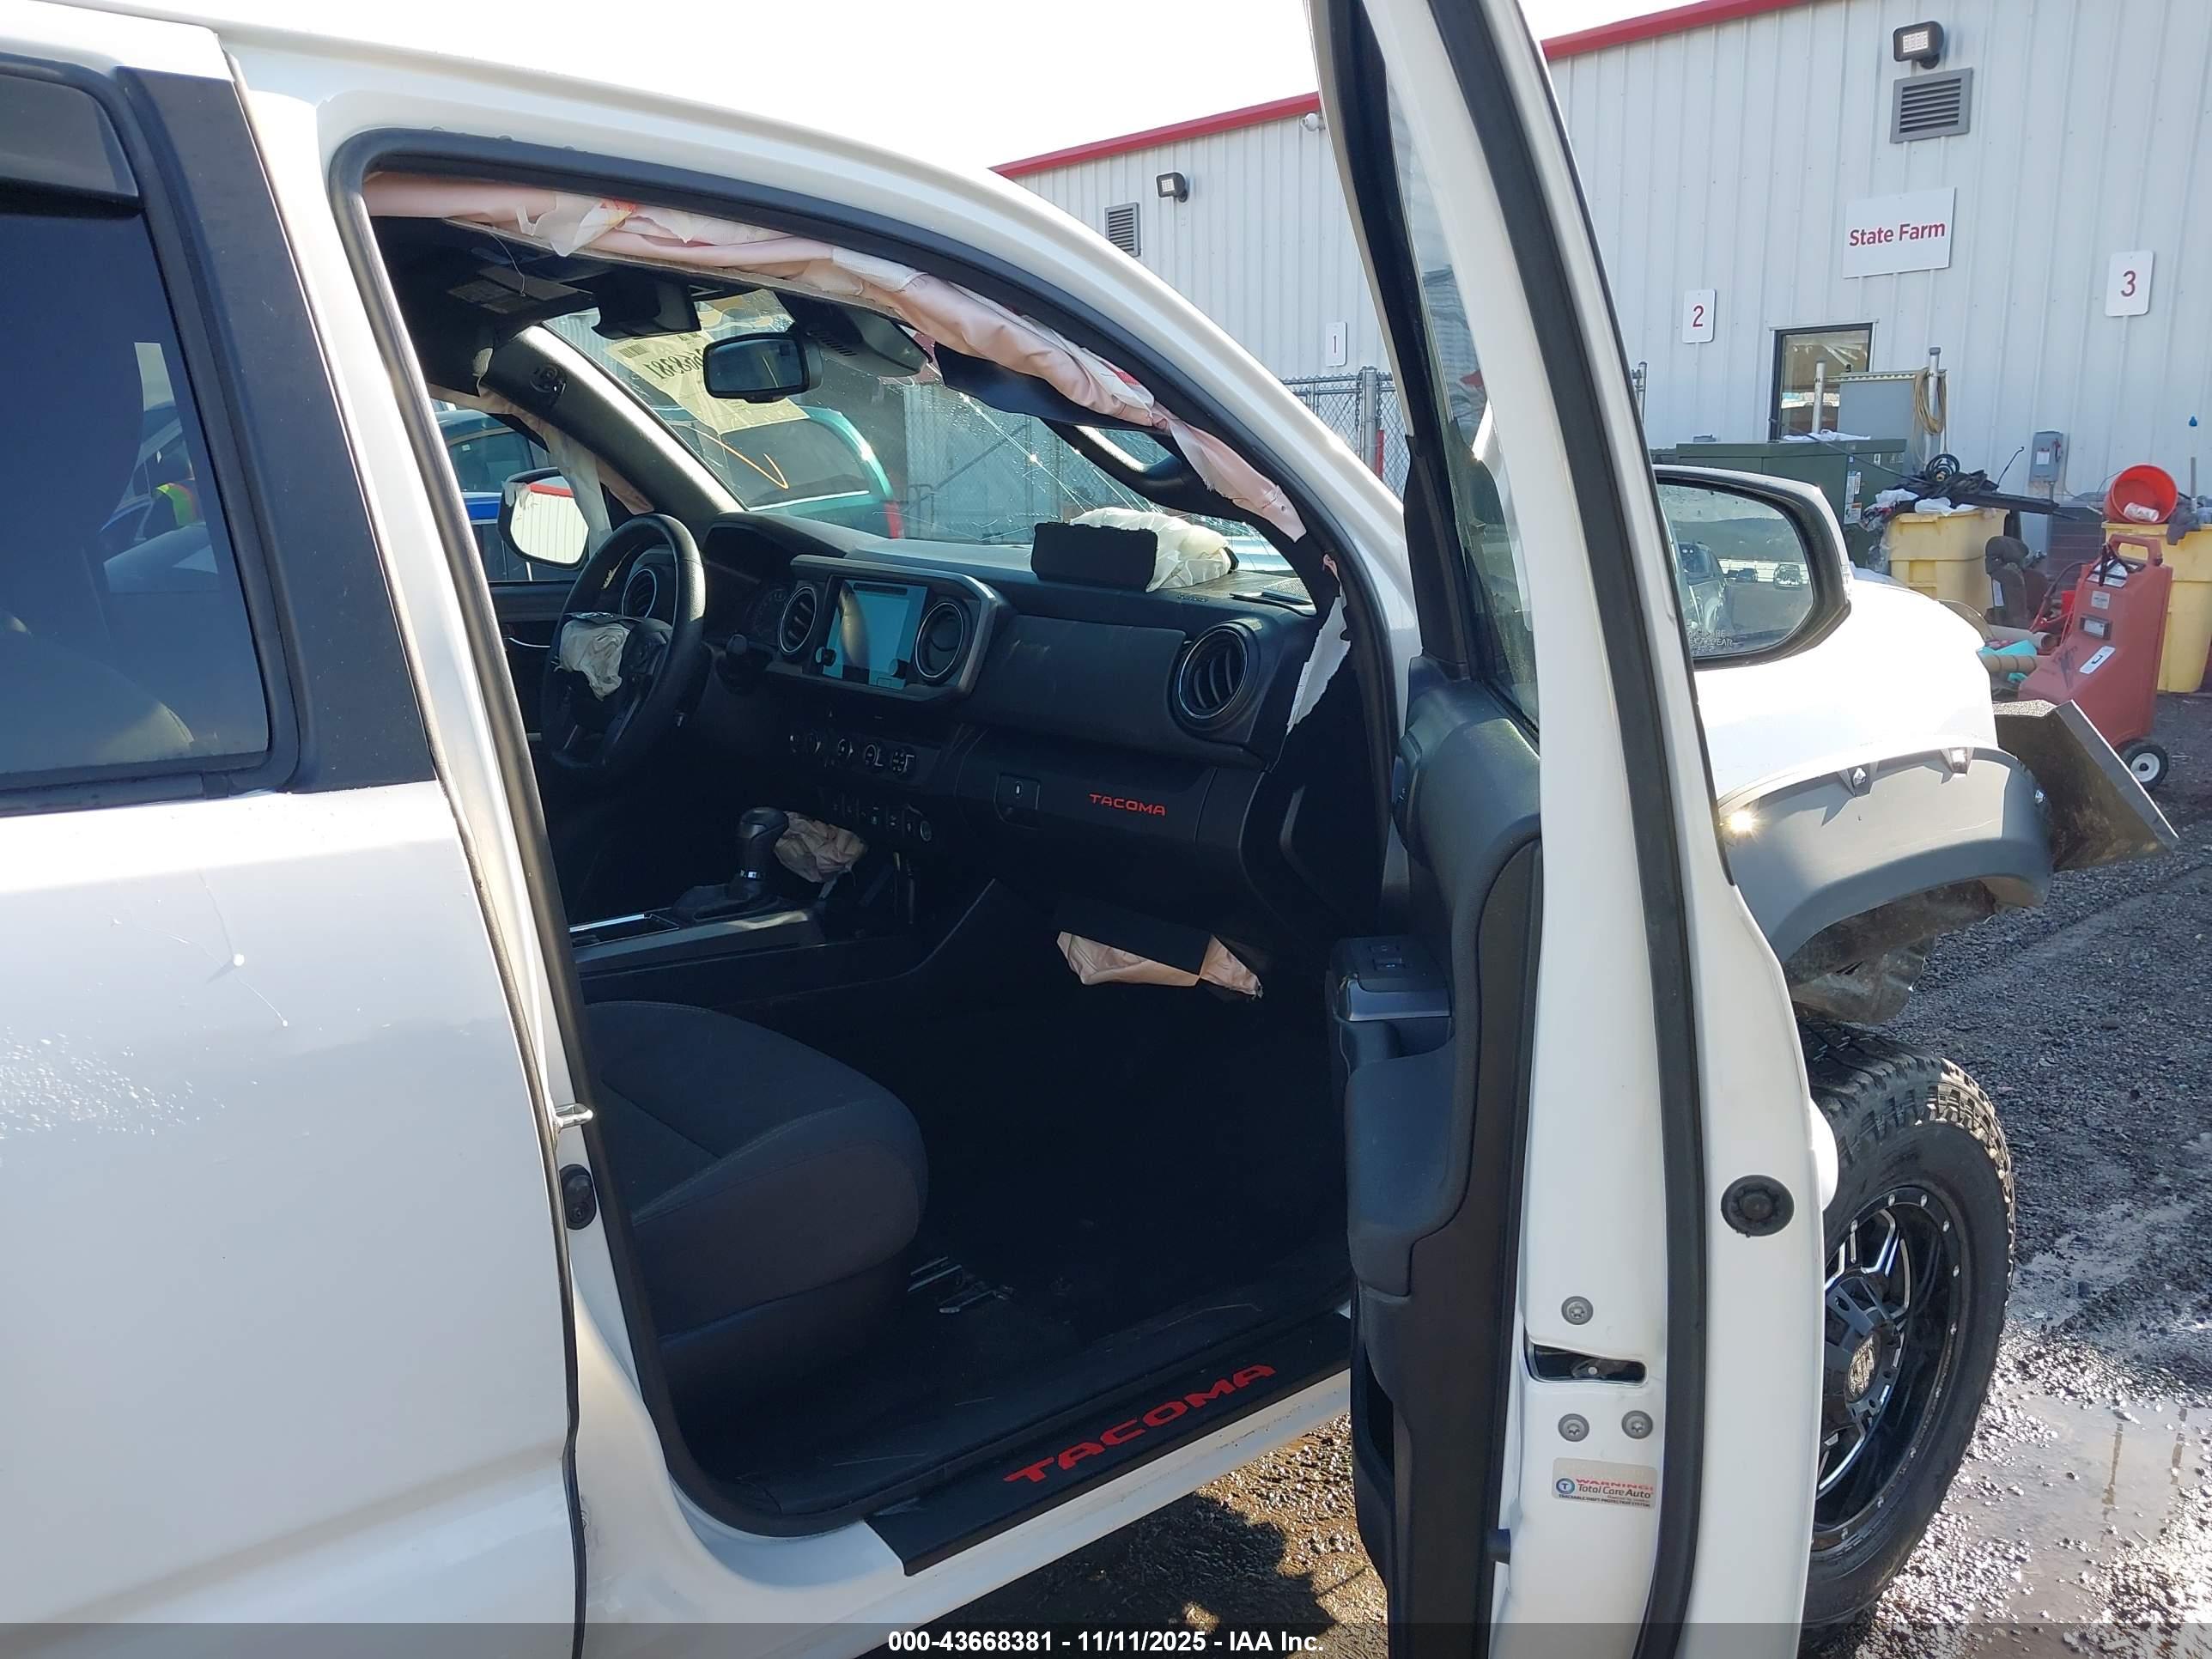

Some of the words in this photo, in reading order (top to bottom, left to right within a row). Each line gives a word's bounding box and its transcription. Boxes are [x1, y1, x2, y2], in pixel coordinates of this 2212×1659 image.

[1849, 227, 1894, 246] State
[1899, 222, 1946, 241] Farm
[2119, 270, 2136, 298] 3
[1692, 305, 1705, 328] 2
[1089, 793, 1167, 817] TACOMA
[1004, 1363, 1277, 1484] TACOMA
[1578, 1483, 1602, 1494] Total
[1602, 1486, 1625, 1496] Care
[1625, 1488, 1651, 1499] Auto
